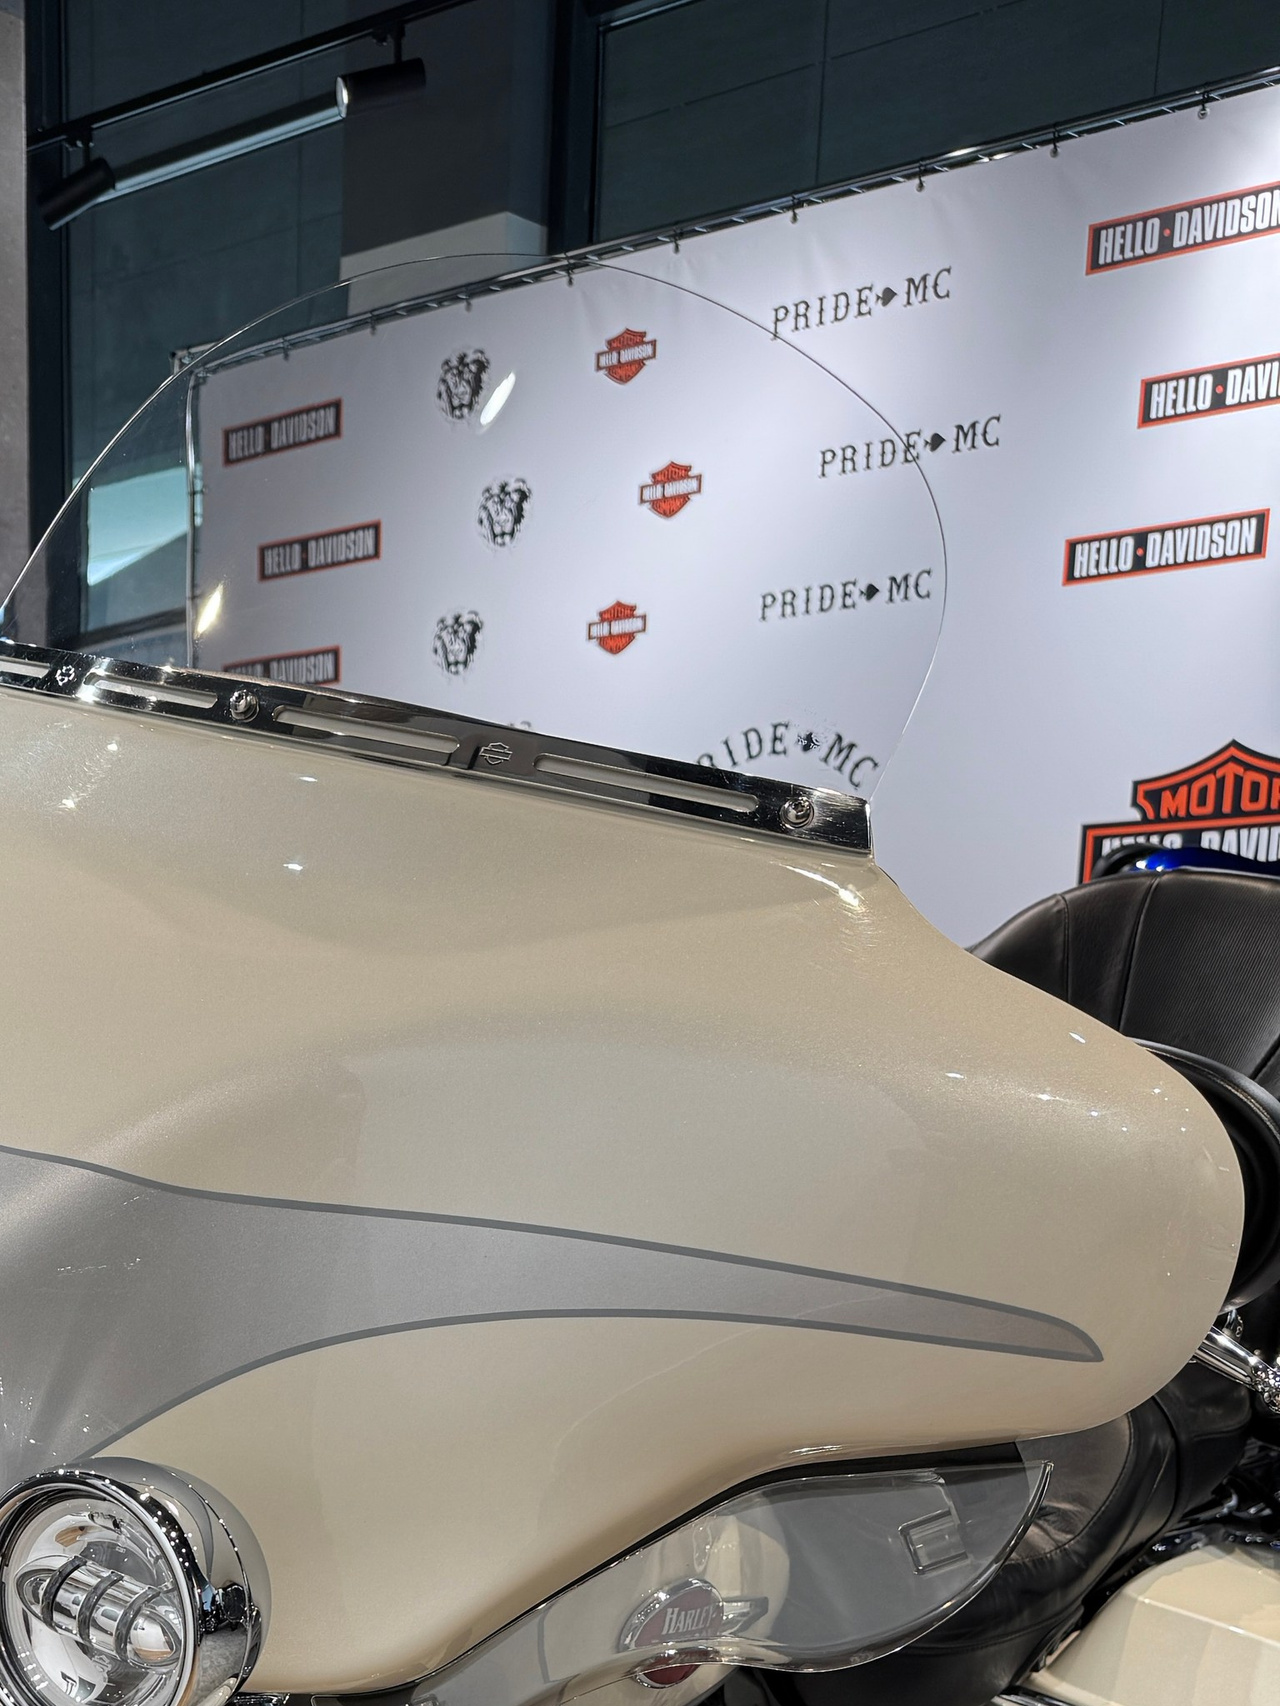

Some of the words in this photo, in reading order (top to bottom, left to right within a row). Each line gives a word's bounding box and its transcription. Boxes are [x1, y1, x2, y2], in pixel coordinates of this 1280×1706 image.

[1098, 217, 1160, 265] HELLO
[770, 283, 874, 341] PRIDE
[903, 266, 952, 308] MC
[1149, 373, 1213, 419] HELLO
[1225, 361, 1280, 406] DAVI
[228, 425, 265, 461] HELLO
[270, 404, 336, 449] DAVIDSON
[818, 428, 921, 479] PRIDE
[952, 414, 1001, 454] MC
[264, 543, 302, 577] HELLO
[307, 527, 376, 568] DAVIDSON
[1073, 536, 1135, 578] HELLO
[1145, 517, 1257, 568] DAVIDSON
[759, 579, 859, 621] PRIDE
[885, 568, 932, 604] MC
[270, 651, 336, 683] DAVIDSON
[819, 732, 879, 790] MC
